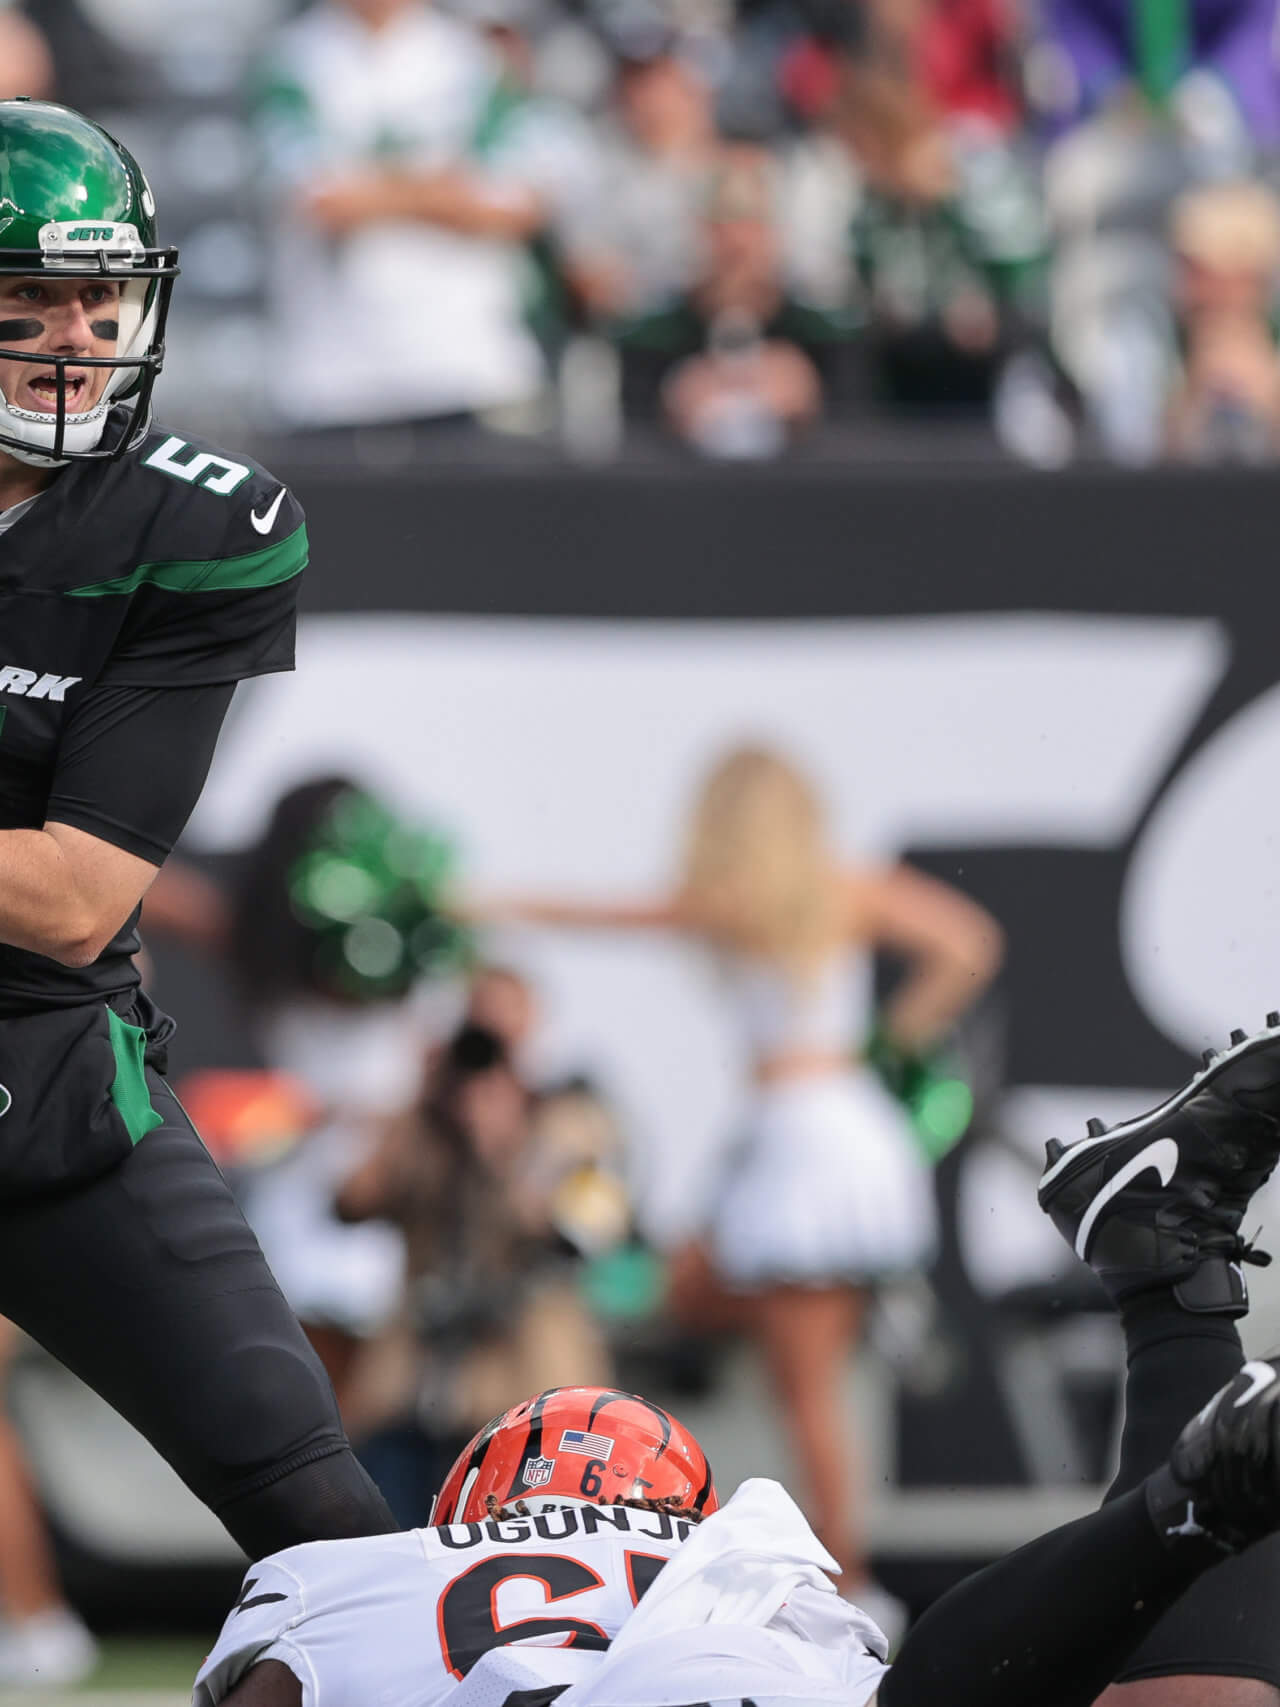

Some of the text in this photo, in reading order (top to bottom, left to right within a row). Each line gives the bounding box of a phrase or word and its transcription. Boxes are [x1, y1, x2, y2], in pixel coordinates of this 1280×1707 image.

[66, 227, 114, 241] JETS
[141, 433, 255, 496] 5
[526, 1469, 547, 1482] NFL
